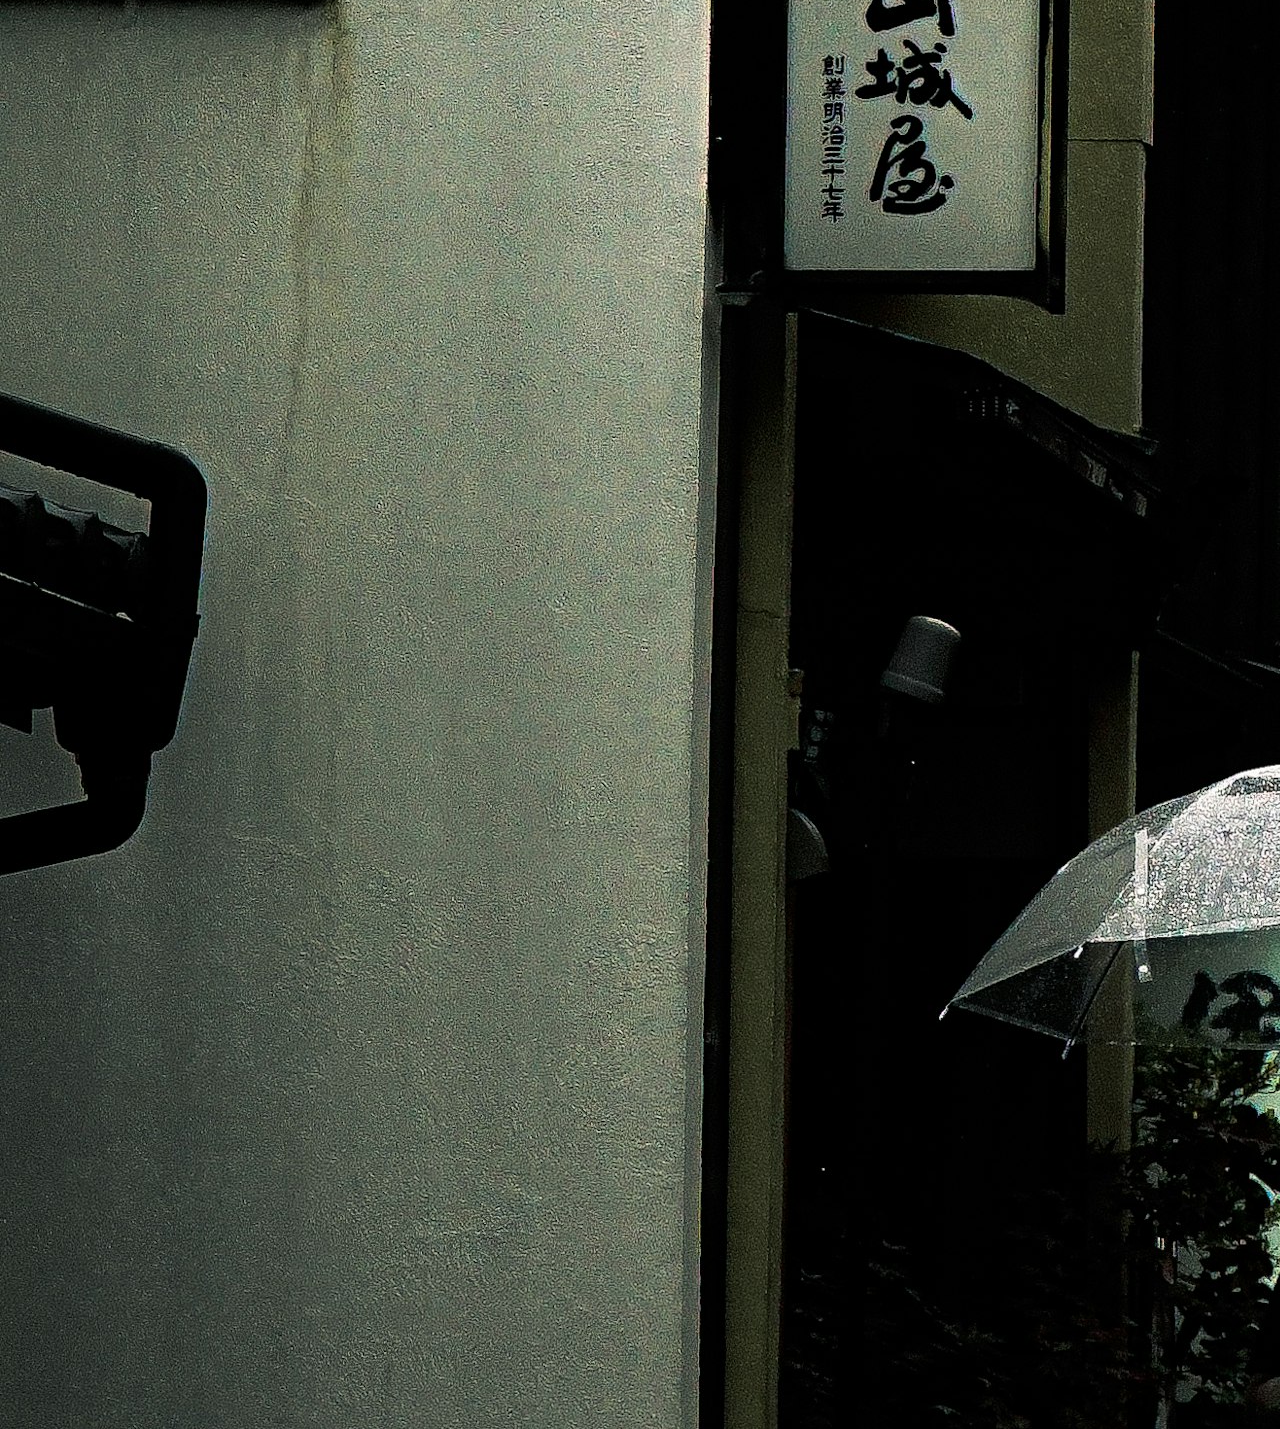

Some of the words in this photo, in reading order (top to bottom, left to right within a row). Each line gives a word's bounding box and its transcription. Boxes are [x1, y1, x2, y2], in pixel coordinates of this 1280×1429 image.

[820, 54, 846, 224] 創業明治三十七年
